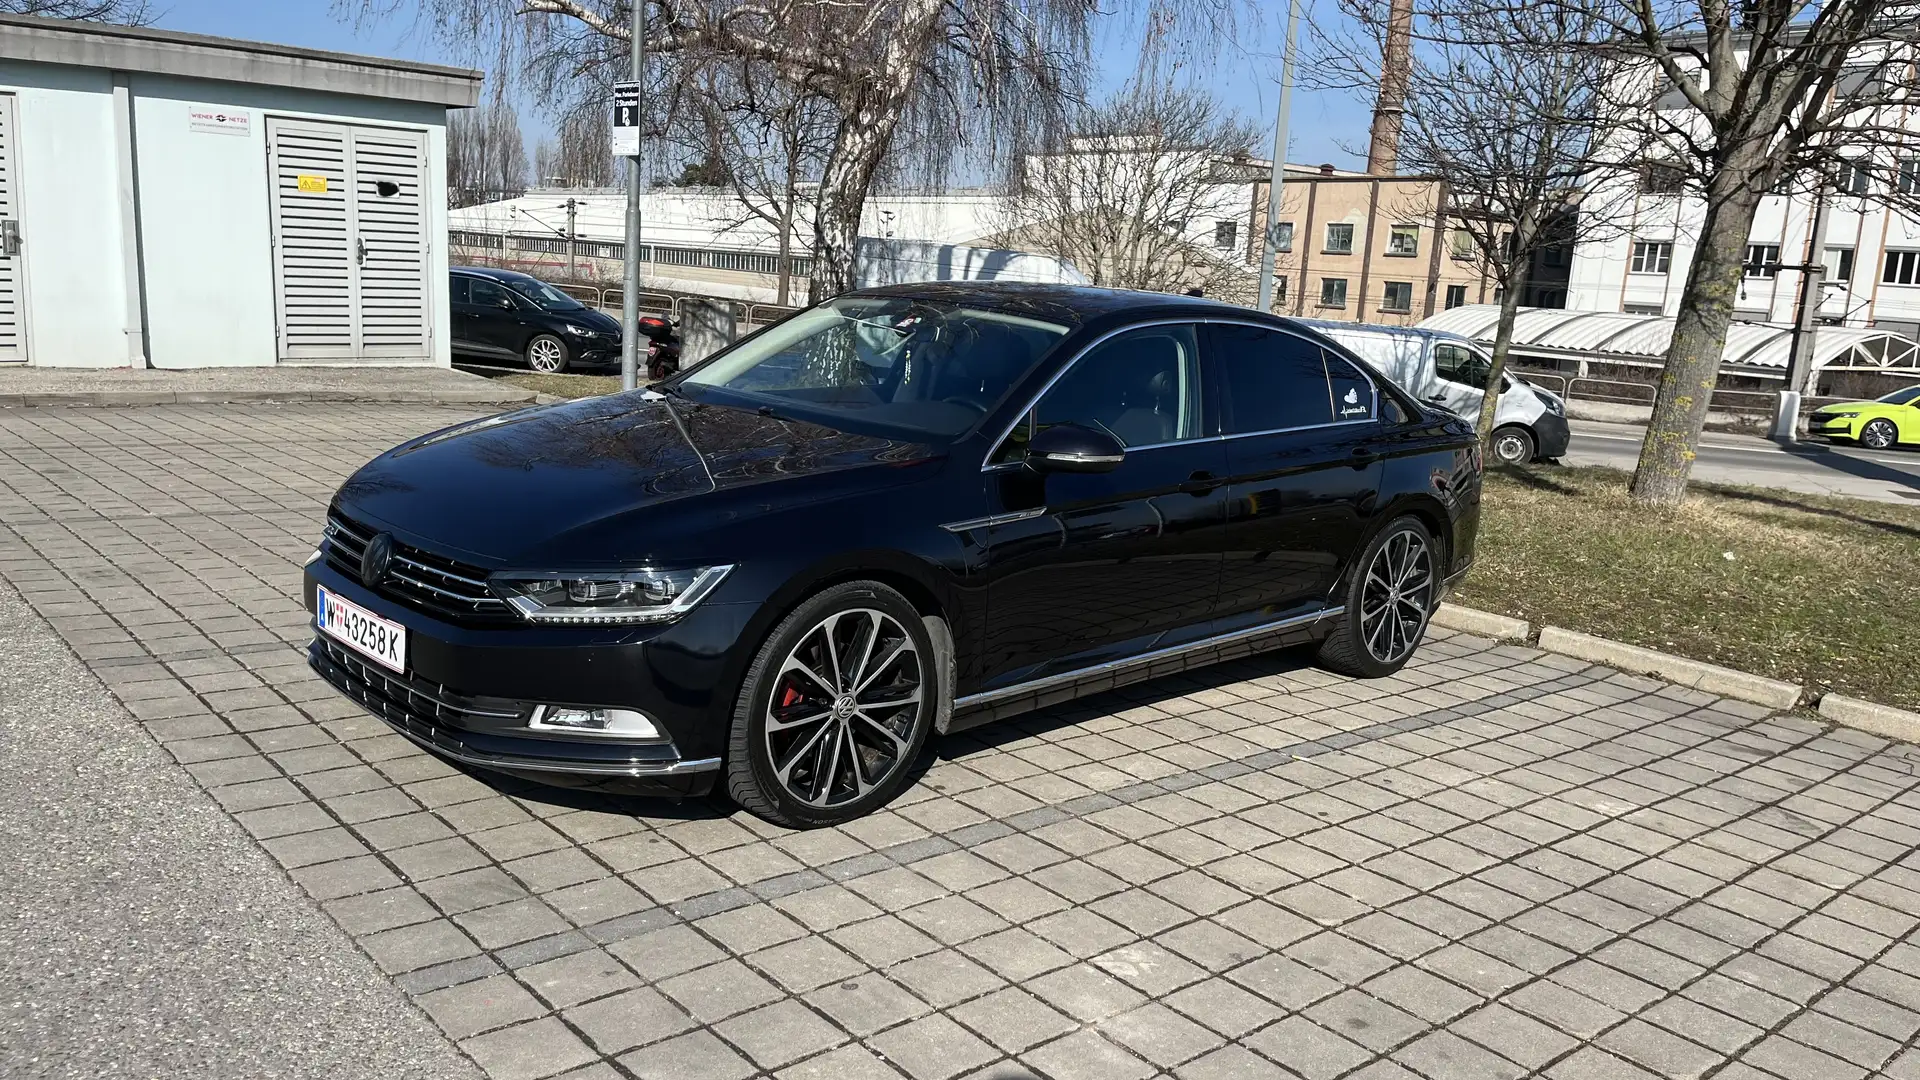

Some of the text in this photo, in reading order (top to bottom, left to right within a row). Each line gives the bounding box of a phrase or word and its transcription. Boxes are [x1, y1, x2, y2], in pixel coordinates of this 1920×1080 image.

[326, 598, 399, 662] W 43258 K
